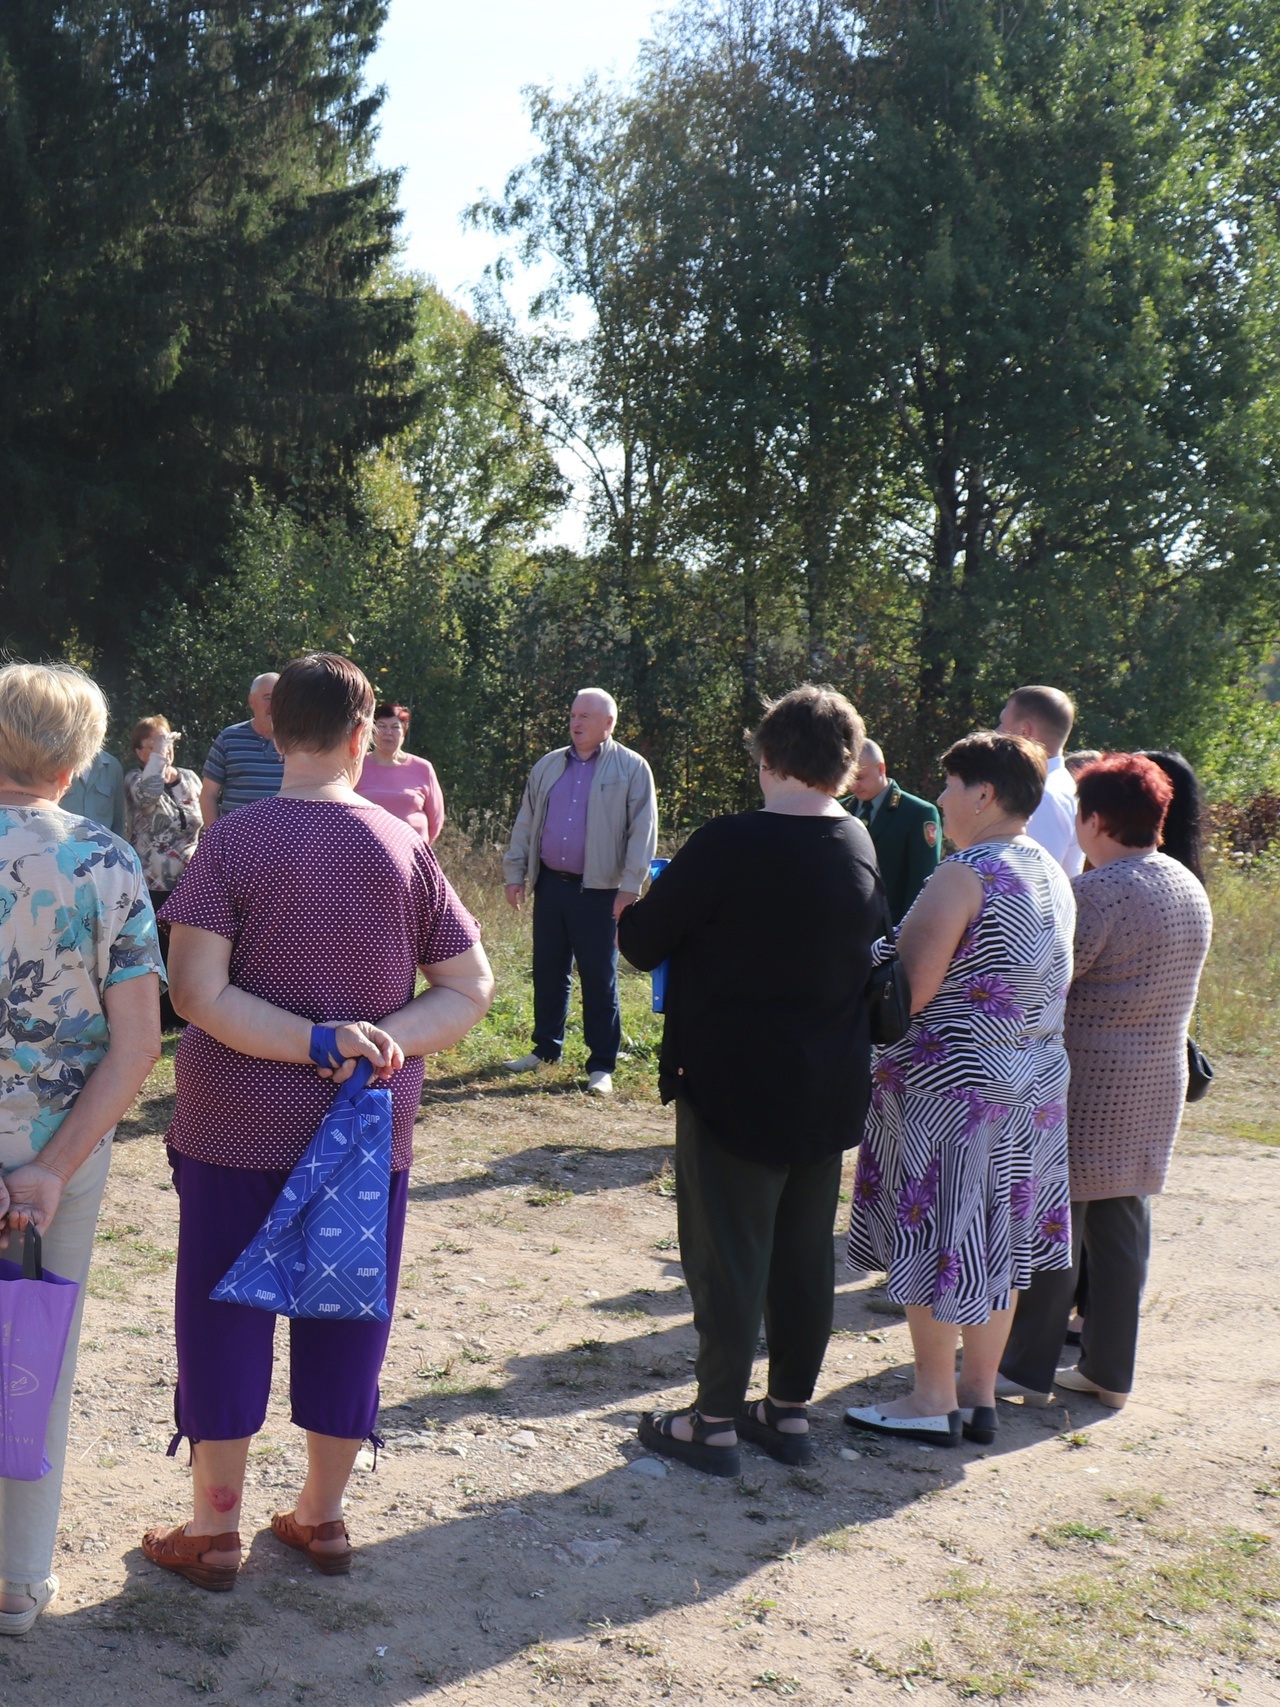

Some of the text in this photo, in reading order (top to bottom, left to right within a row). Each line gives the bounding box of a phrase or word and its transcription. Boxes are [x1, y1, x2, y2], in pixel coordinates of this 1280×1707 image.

[330, 1128, 348, 1146] ЛДПР
[282, 1186, 297, 1202] ЛДПР
[358, 1191, 381, 1200] ЛДПР
[319, 1227, 342, 1237] ЛДПР
[356, 1267, 379, 1277] ЛДПР
[255, 1289, 276, 1301] ЛДПР
[317, 1303, 341, 1312] ЛДПР
